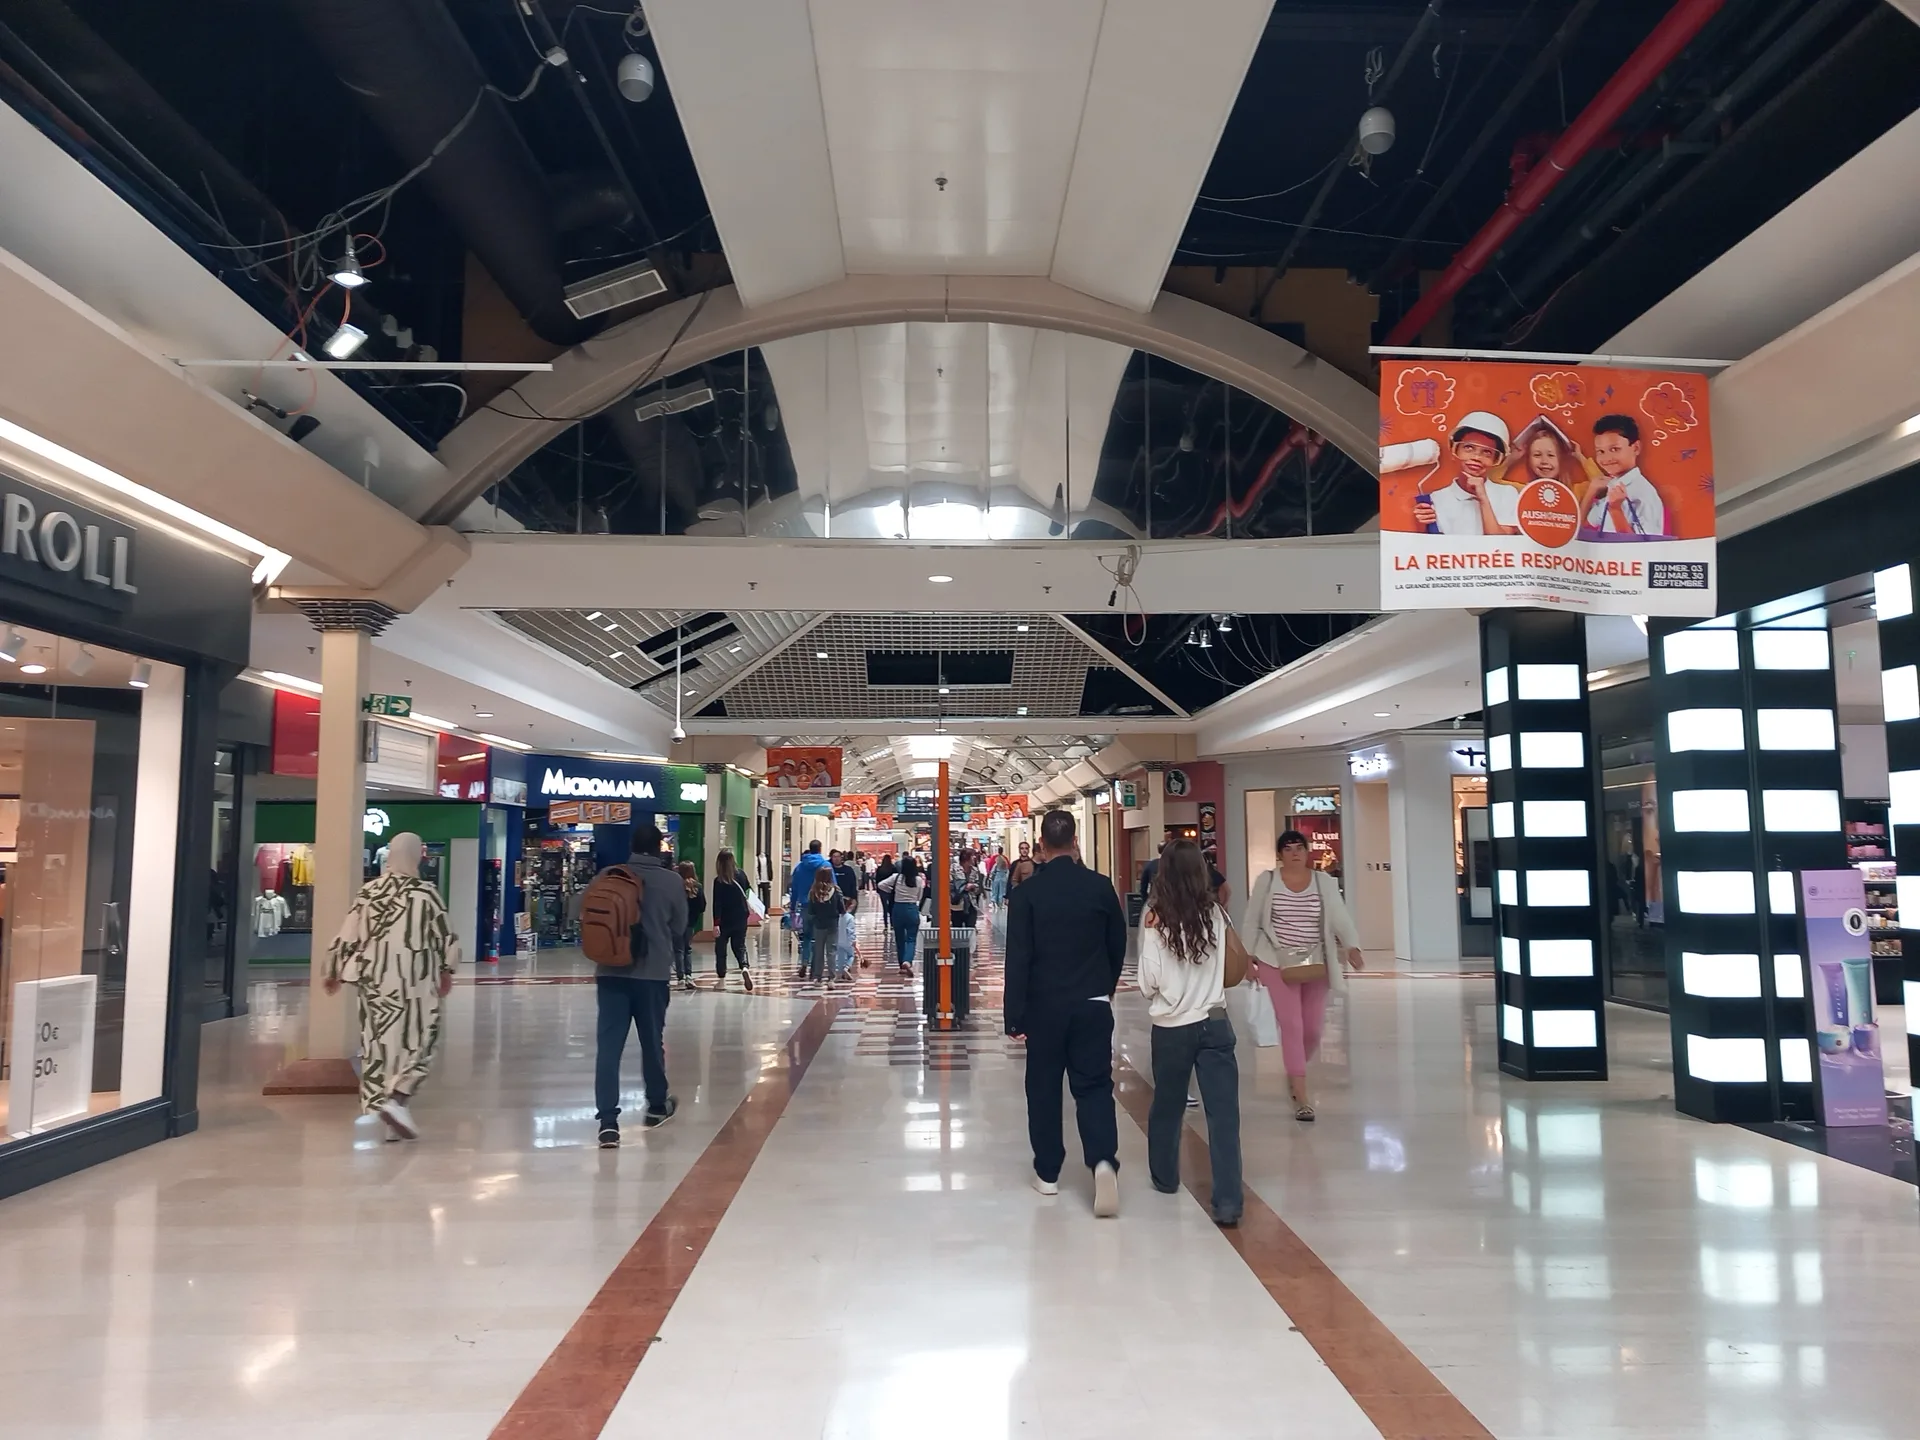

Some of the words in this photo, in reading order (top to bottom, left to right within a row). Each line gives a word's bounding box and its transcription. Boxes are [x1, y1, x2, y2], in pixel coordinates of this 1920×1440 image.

[2, 493, 138, 594] ROLL
[1395, 556, 1420, 570] LA
[1426, 549, 1515, 570] RENTRÉE
[1521, 553, 1642, 577] RESPONSABLE
[1654, 564, 1667, 572] DU
[1653, 579, 1704, 587] SEPTEMBRE
[541, 768, 655, 798] MICROMANIA
